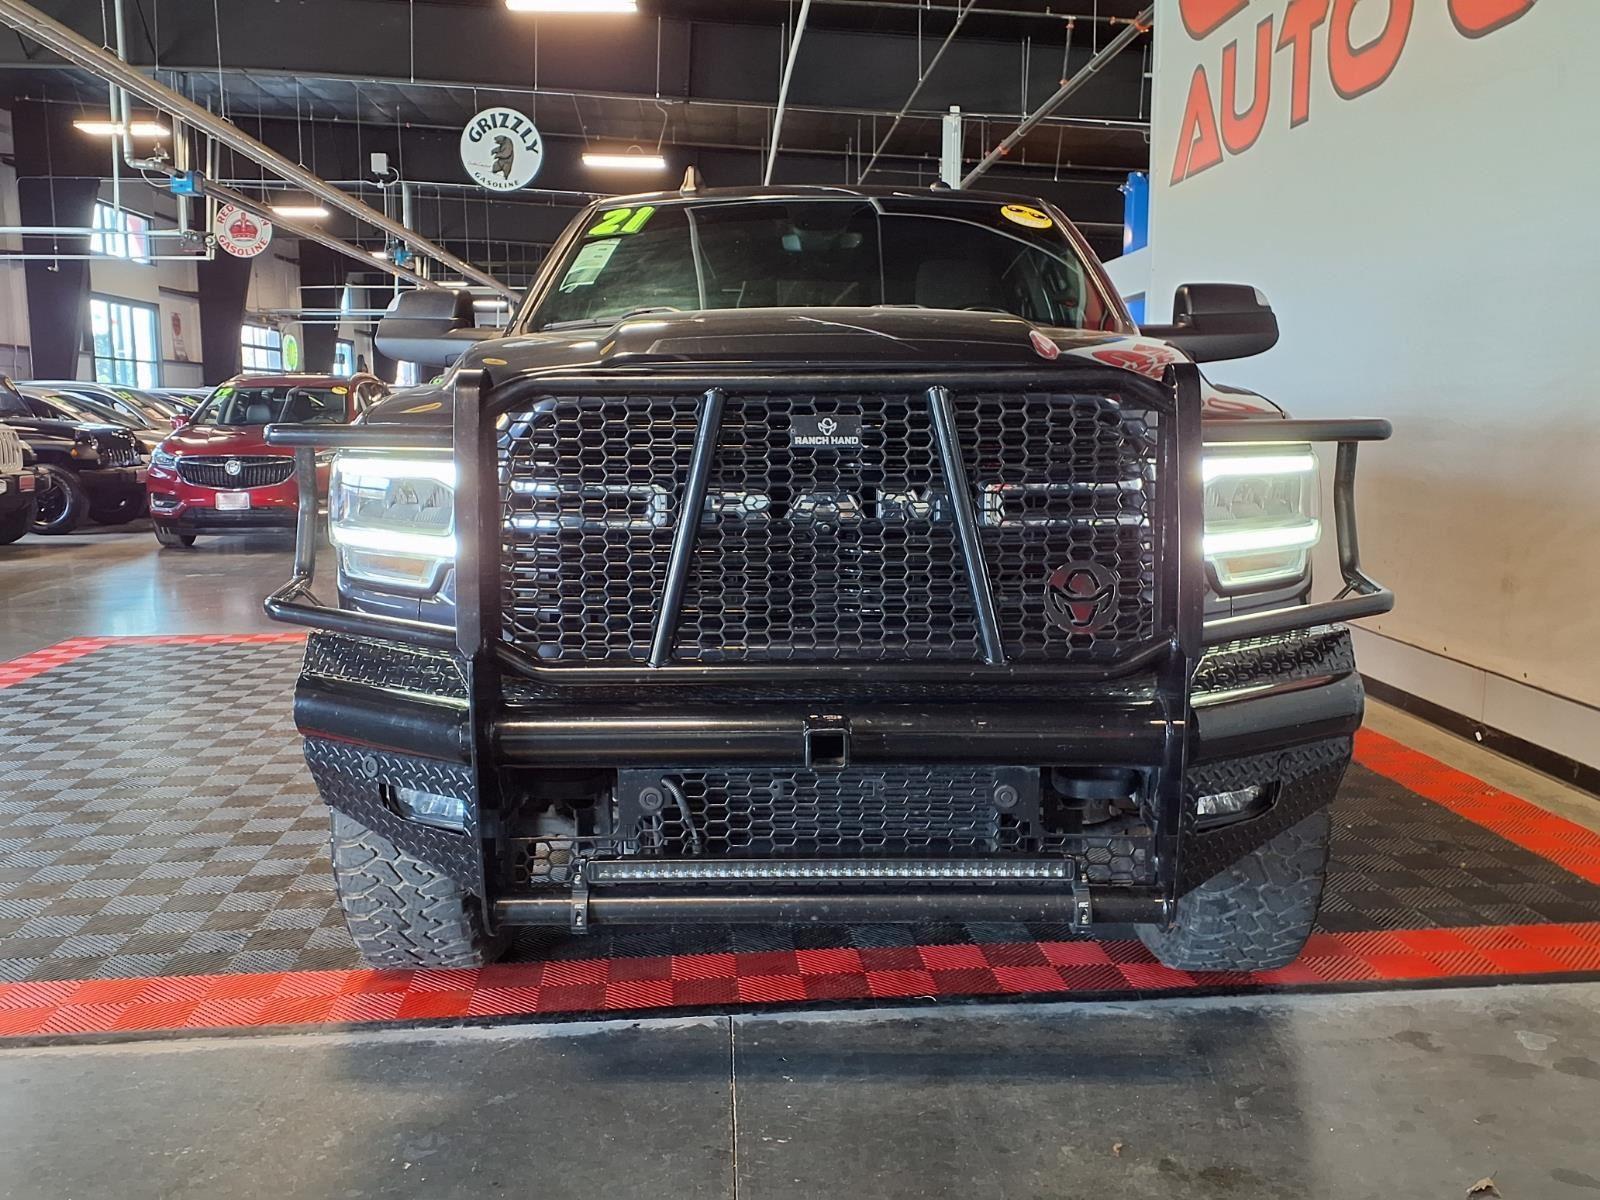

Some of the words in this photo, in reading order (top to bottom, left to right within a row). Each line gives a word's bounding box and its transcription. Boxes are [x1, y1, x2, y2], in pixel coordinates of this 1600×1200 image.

[1170, 0, 1414, 187] AUTO
[468, 112, 539, 154] GRIZZLY
[474, 171, 520, 188] GASOLINE
[217, 204, 234, 224] RED
[588, 206, 655, 236] 21
[219, 234, 268, 256] GASOLINE
[794, 436, 830, 445] RANCH
[831, 436, 859, 445] HAND
